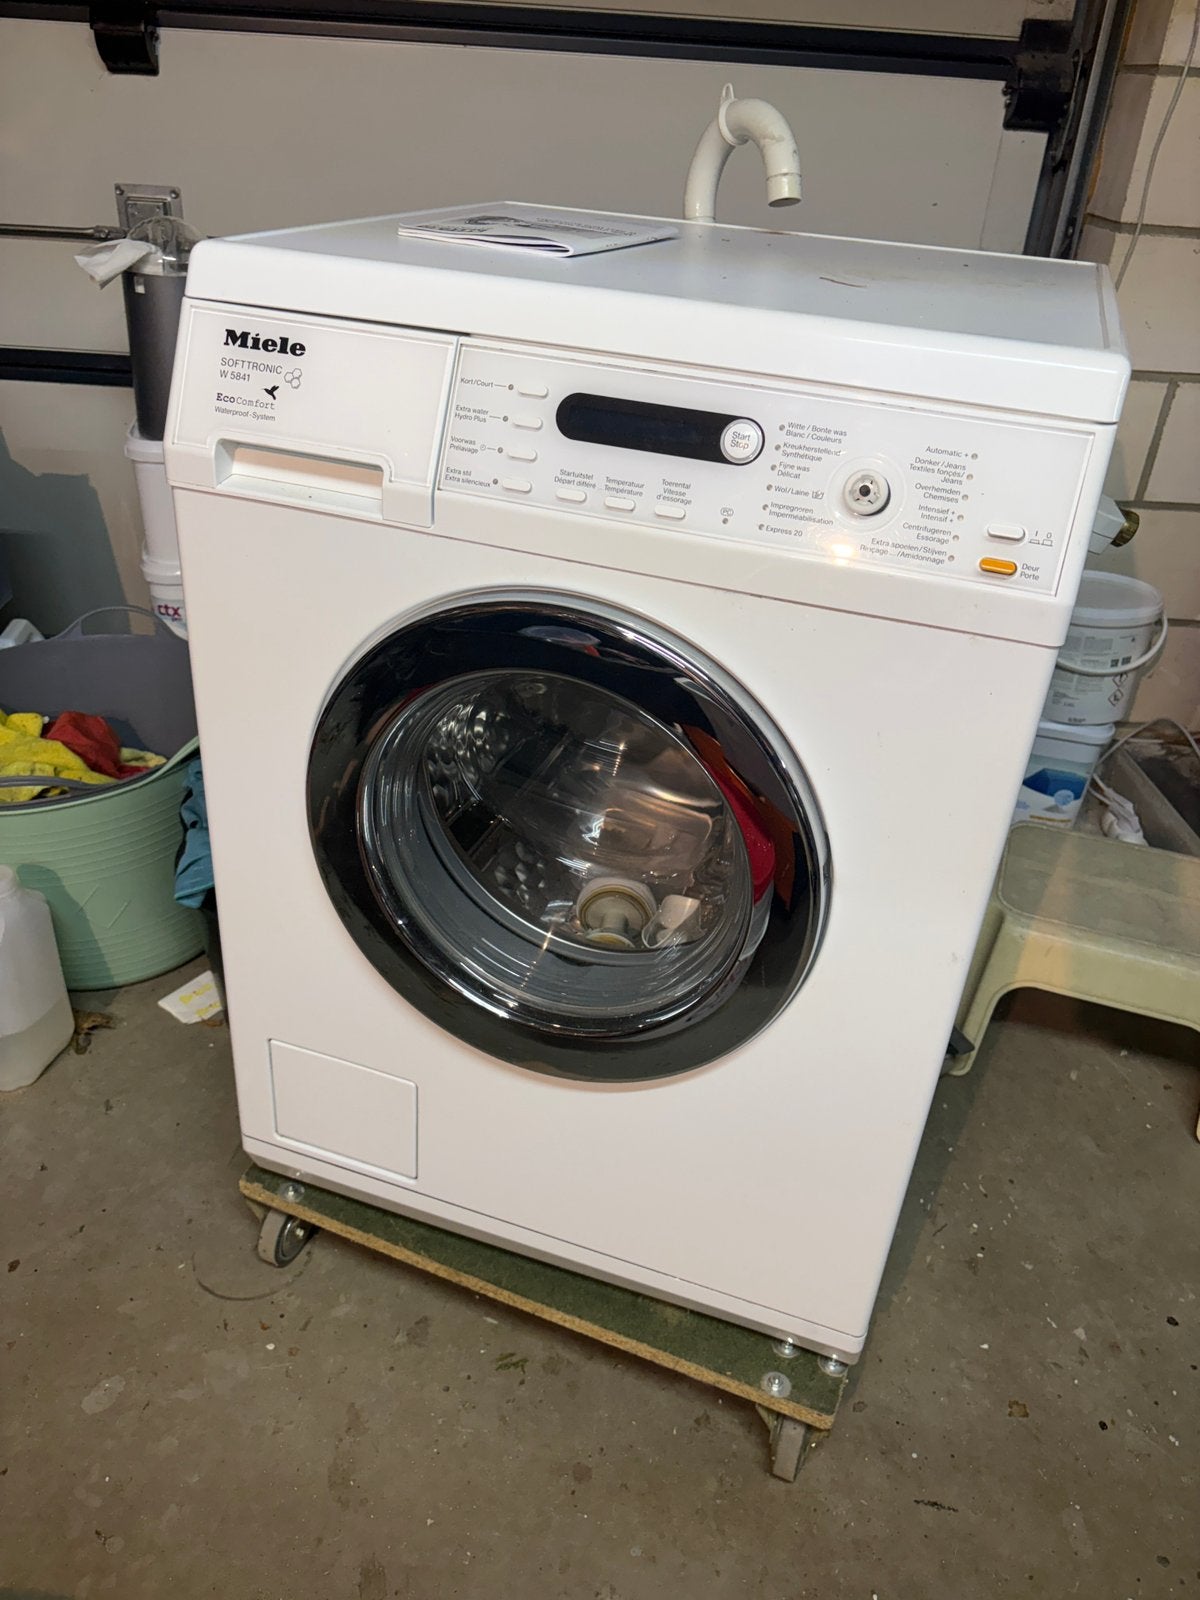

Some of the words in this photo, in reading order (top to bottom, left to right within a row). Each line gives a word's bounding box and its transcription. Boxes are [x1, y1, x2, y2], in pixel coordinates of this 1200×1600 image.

[224, 329, 306, 356] Miele
[220, 357, 283, 375] SOFTTRONIC
[220, 370, 228, 379] W
[230, 371, 251, 382] 5841
[460, 377, 494, 388] Kort/Court
[216, 392, 276, 410] EcoComfort
[455, 404, 471, 413] Extra
[472, 407, 489, 416] water
[454, 413, 473, 422] Hydro
[473, 415, 487, 424] Plus
[787, 421, 806, 431] Witte
[811, 425, 832, 435] Bonte
[833, 429, 848, 437] was
[450, 435, 476, 446] Voorwas
[731, 431, 751, 441] Start
[785, 429, 806, 439] Blanc
[811, 433, 843, 444] Couleurs
[730, 440, 750, 451] Stop
[925, 445, 963, 458] Automatic
[781, 449, 823, 462] Synthétique
[778, 461, 795, 471] Fijne
[796, 465, 810, 473] was
[909, 463, 936, 475] Textiles
[914, 456, 967, 471] Donker/Jeans
[446, 467, 462, 476] Extra
[462, 469, 472, 477] stil
[559, 468, 594, 481] Startuitstel
[777, 469, 801, 479] Délicat
[444, 474, 461, 483] Extra
[461, 476, 491, 488] silencieux
[554, 476, 575, 488] Départ
[605, 476, 645, 489] Temperatuur
[661, 478, 692, 490] Toerental
[940, 477, 963, 486] Jeans
[604, 484, 644, 497] Température
[663, 487, 687, 497] Vitesse
[774, 485, 810, 497] Wol/Laine
[914, 482, 961, 496] Overhemden
[656, 493, 692, 506] d'essorage
[923, 491, 959, 504] Chemises
[918, 504, 950, 515] Intensief
[920, 512, 948, 523] Intensif
[765, 525, 793, 536] Express
[793, 529, 803, 538] 20
[902, 522, 952, 537] Centrifugeren
[871, 538, 890, 548] Extra
[916, 532, 950, 546] Essorage
[1021, 563, 1040, 573] Deur
[1020, 571, 1040, 581] Porte
[157, 604, 181, 617] ctx
